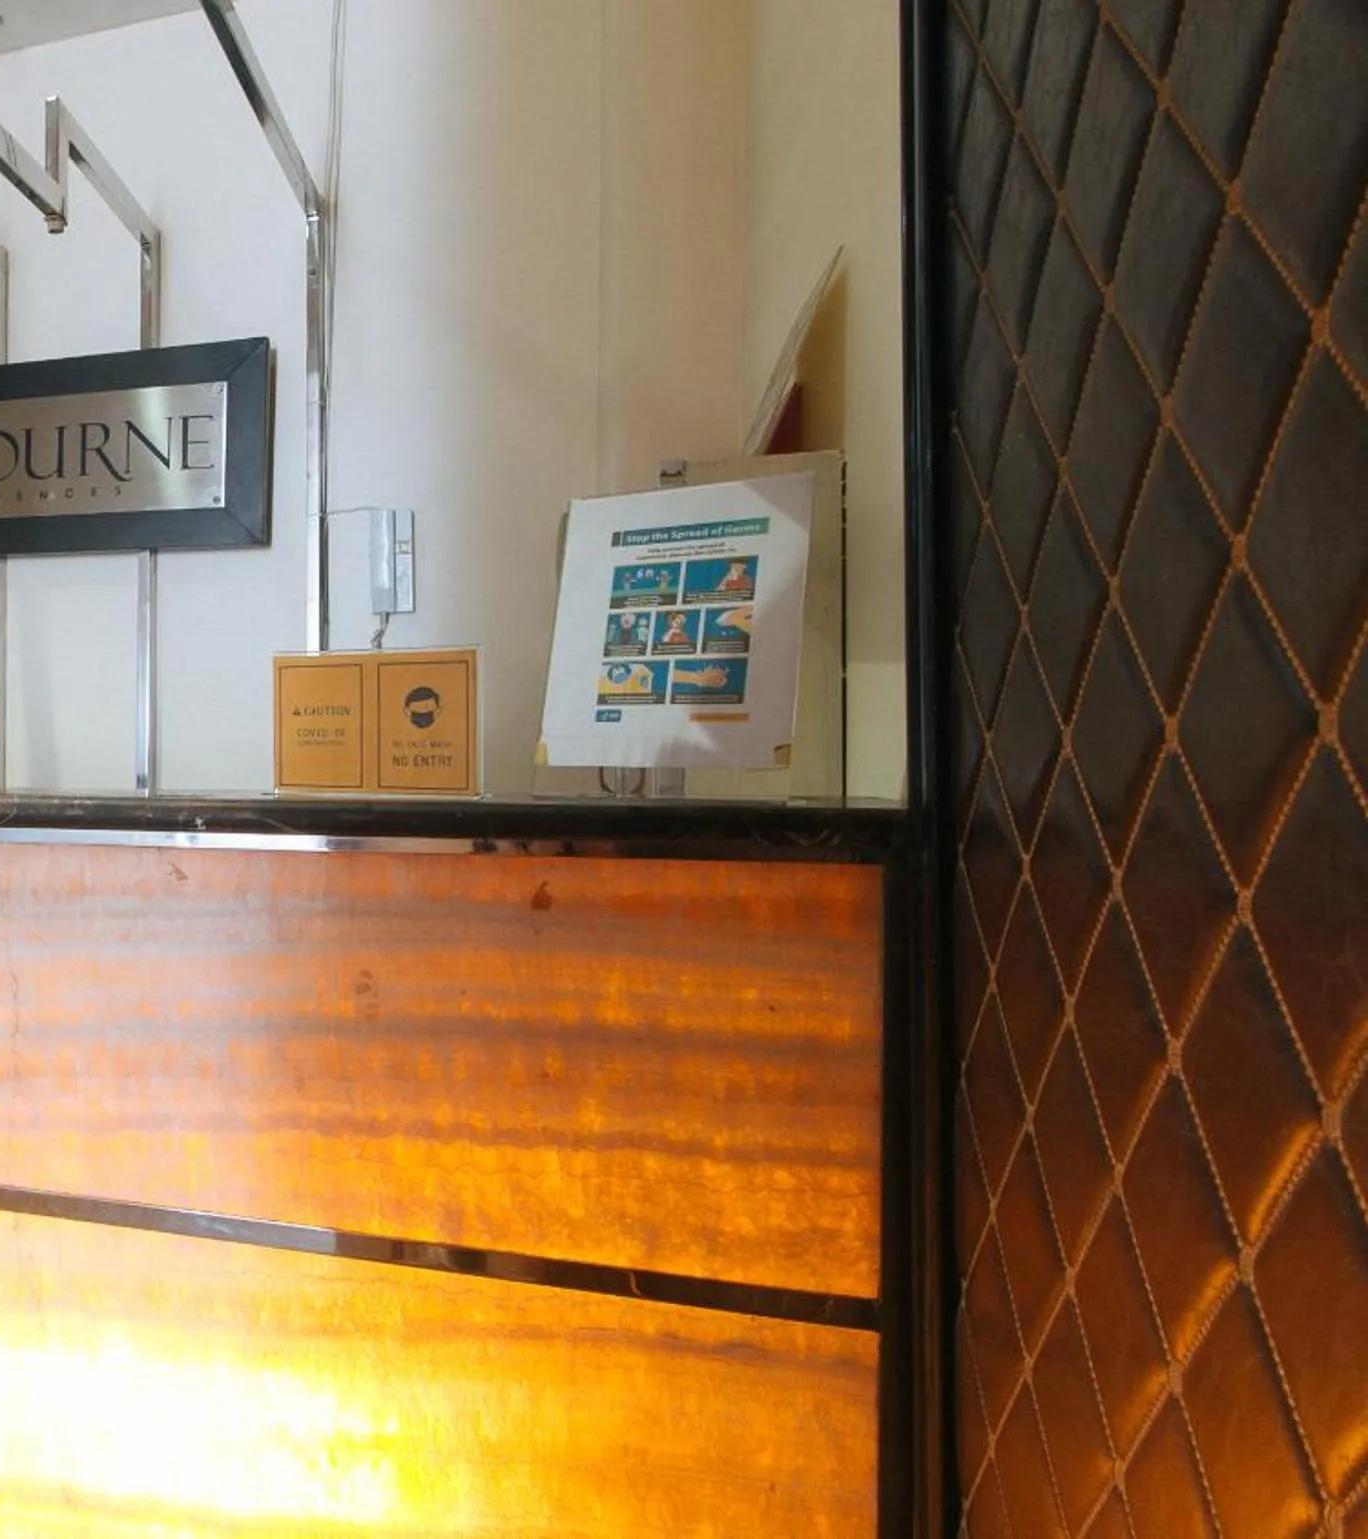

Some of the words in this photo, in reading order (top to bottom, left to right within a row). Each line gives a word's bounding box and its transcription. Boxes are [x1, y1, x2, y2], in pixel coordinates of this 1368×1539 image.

[625, 534, 650, 544] Stop
[651, 531, 668, 541] the
[671, 527, 708, 541] Spread
[711, 527, 722, 536] of
[303, 705, 351, 717] CAUTION
[392, 755, 408, 768] NO
[413, 754, 453, 768] ENTRY
